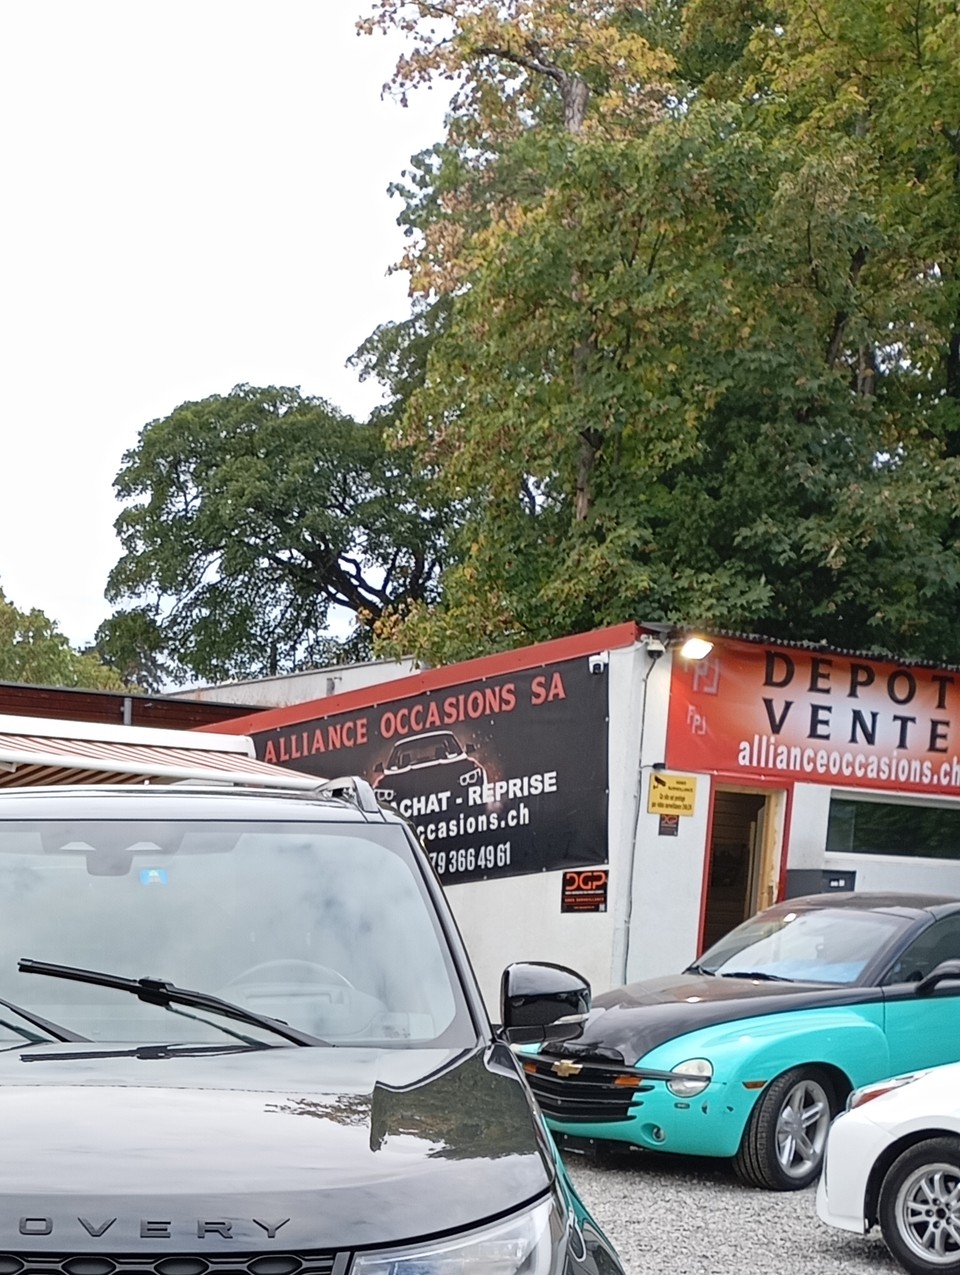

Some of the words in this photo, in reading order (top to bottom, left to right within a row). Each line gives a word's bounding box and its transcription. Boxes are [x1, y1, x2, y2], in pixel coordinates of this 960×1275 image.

[264, 718, 368, 763] ALLIANCE
[380, 683, 516, 738] OCCASIONS
[531, 672, 566, 705] SA
[761, 696, 951, 754] VENTE
[738, 734, 960, 787] allianceoccasions.ch
[468, 771, 557, 806] REPRISE
[449, 846, 476, 873] 366
[478, 844, 494, 870] 49
[497, 841, 511, 867] 61
